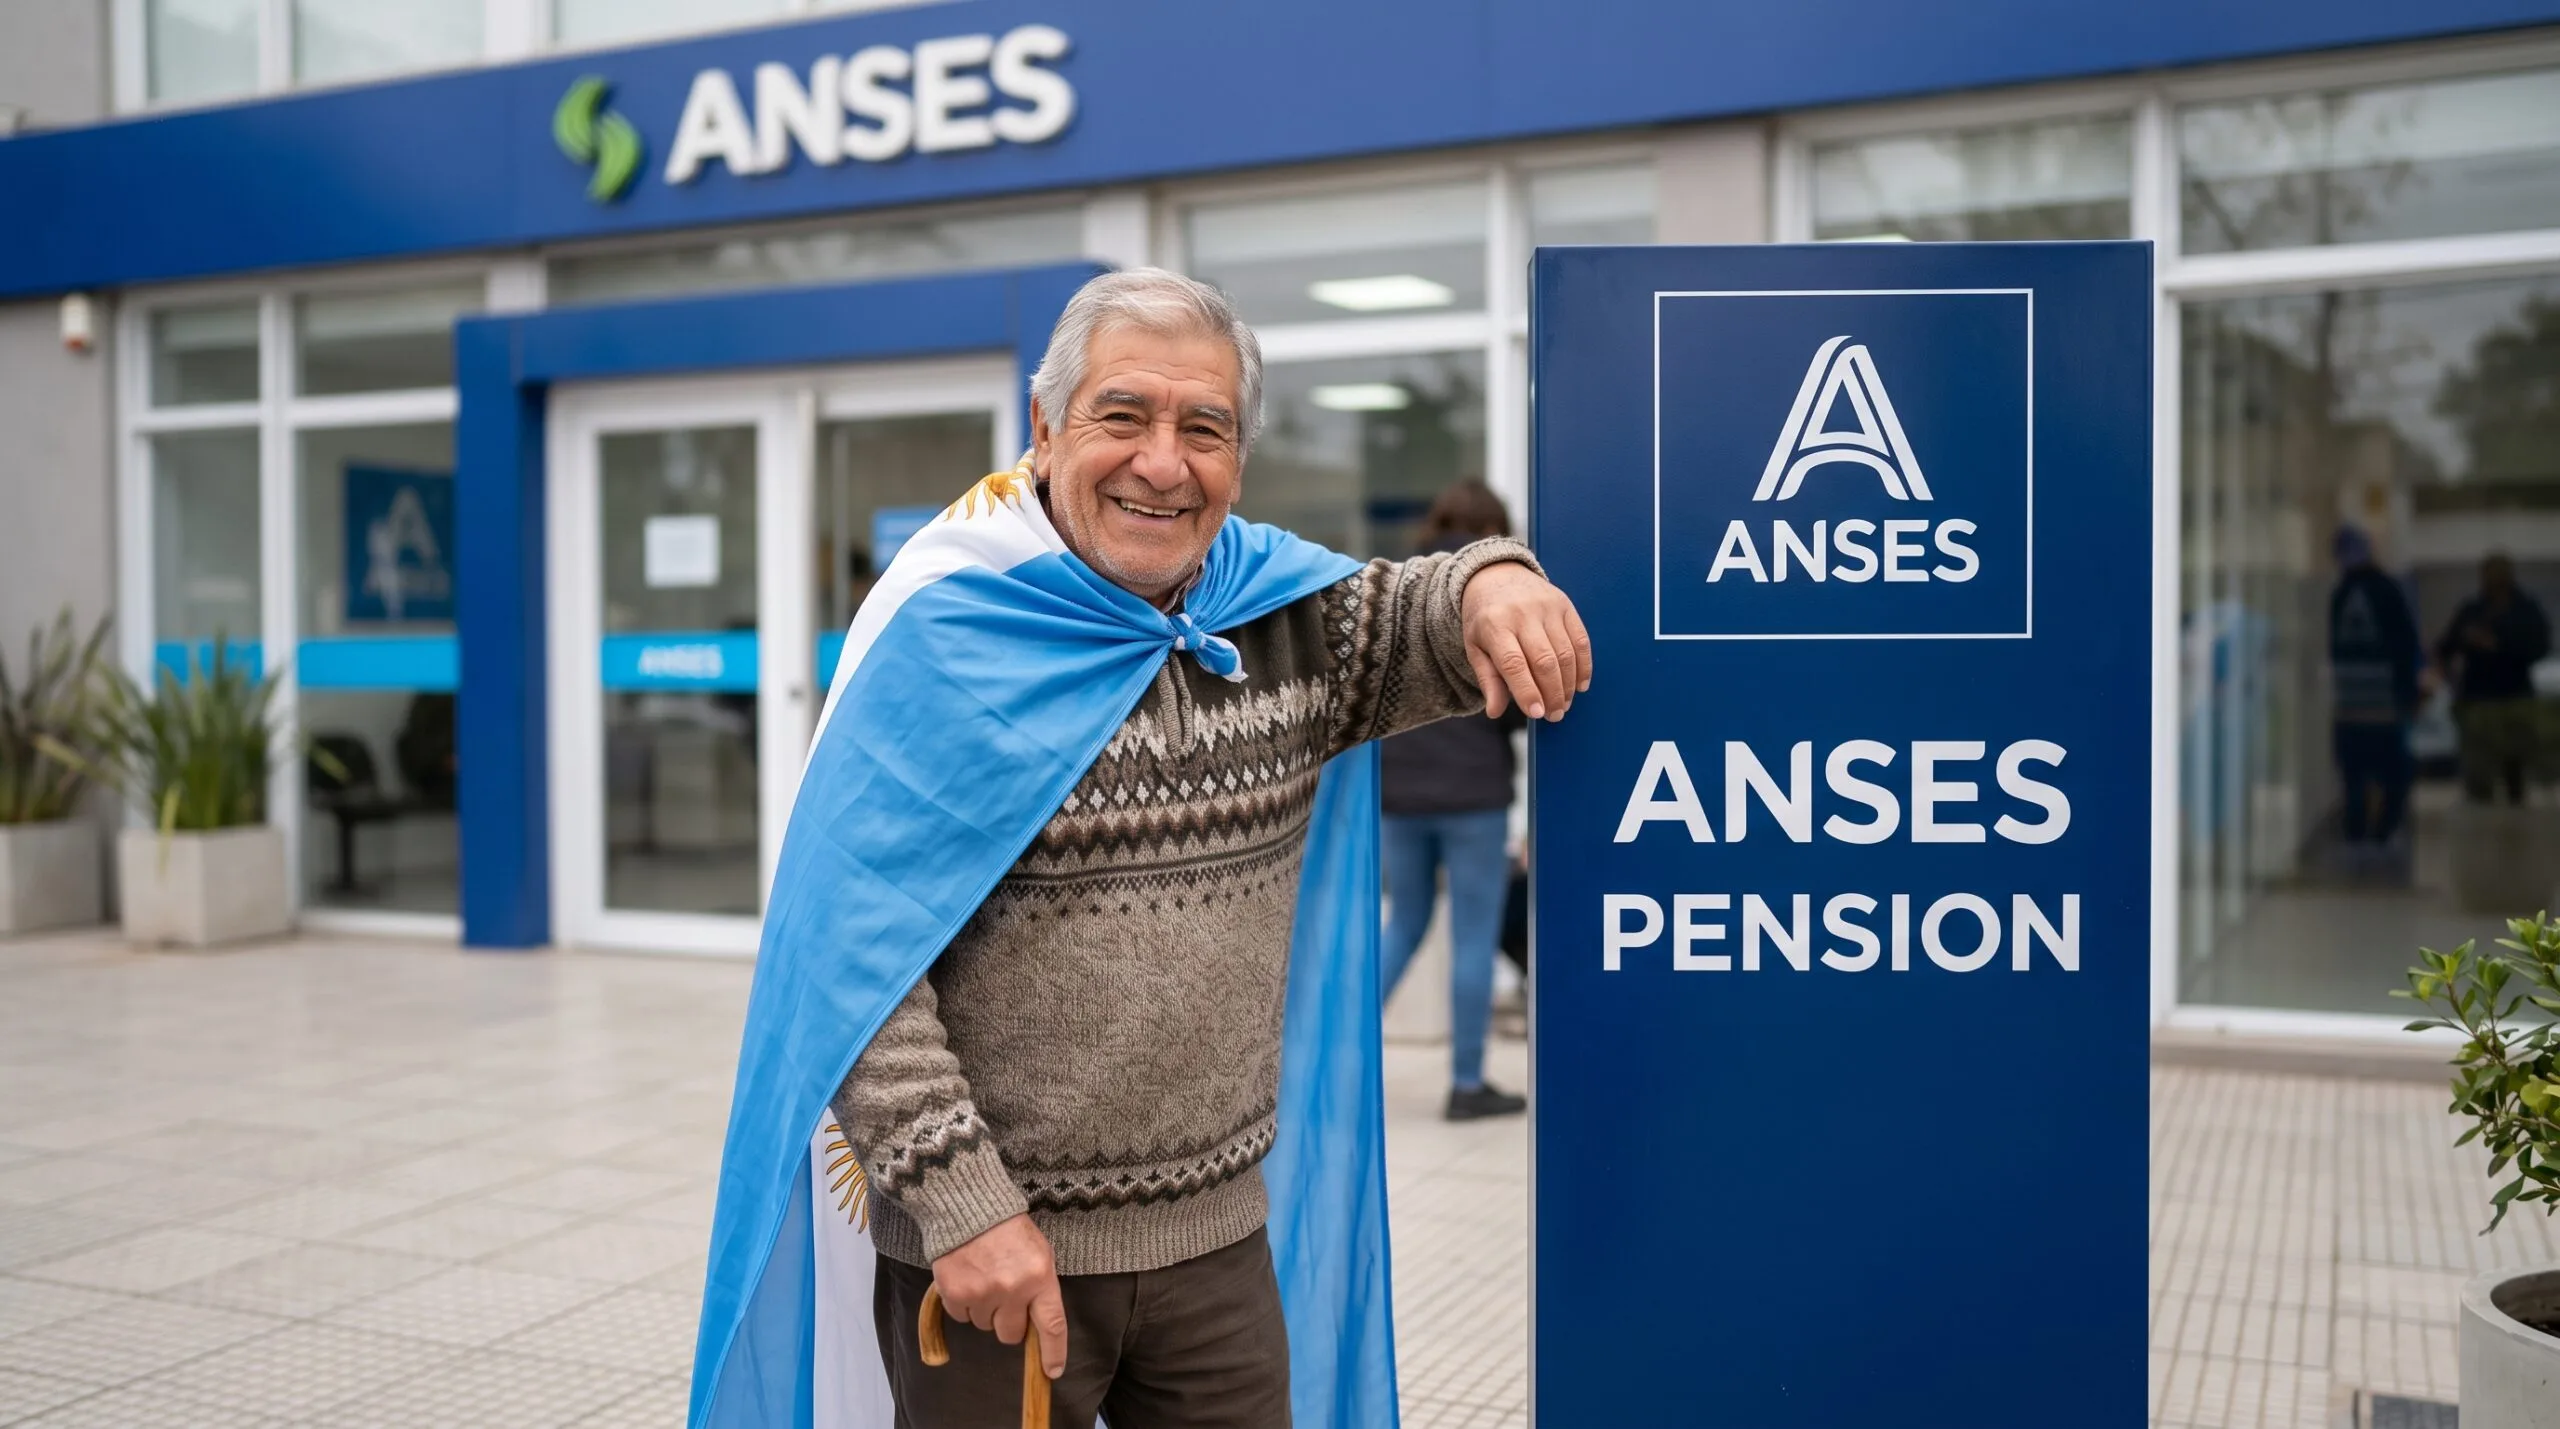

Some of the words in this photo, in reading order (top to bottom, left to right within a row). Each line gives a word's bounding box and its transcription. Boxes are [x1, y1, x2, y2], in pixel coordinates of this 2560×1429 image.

[666, 25, 1076, 183] ANSES
[1707, 518, 1980, 583] ANSES
[1613, 739, 2071, 845] ANSES
[1603, 892, 2080, 973] PENSION
